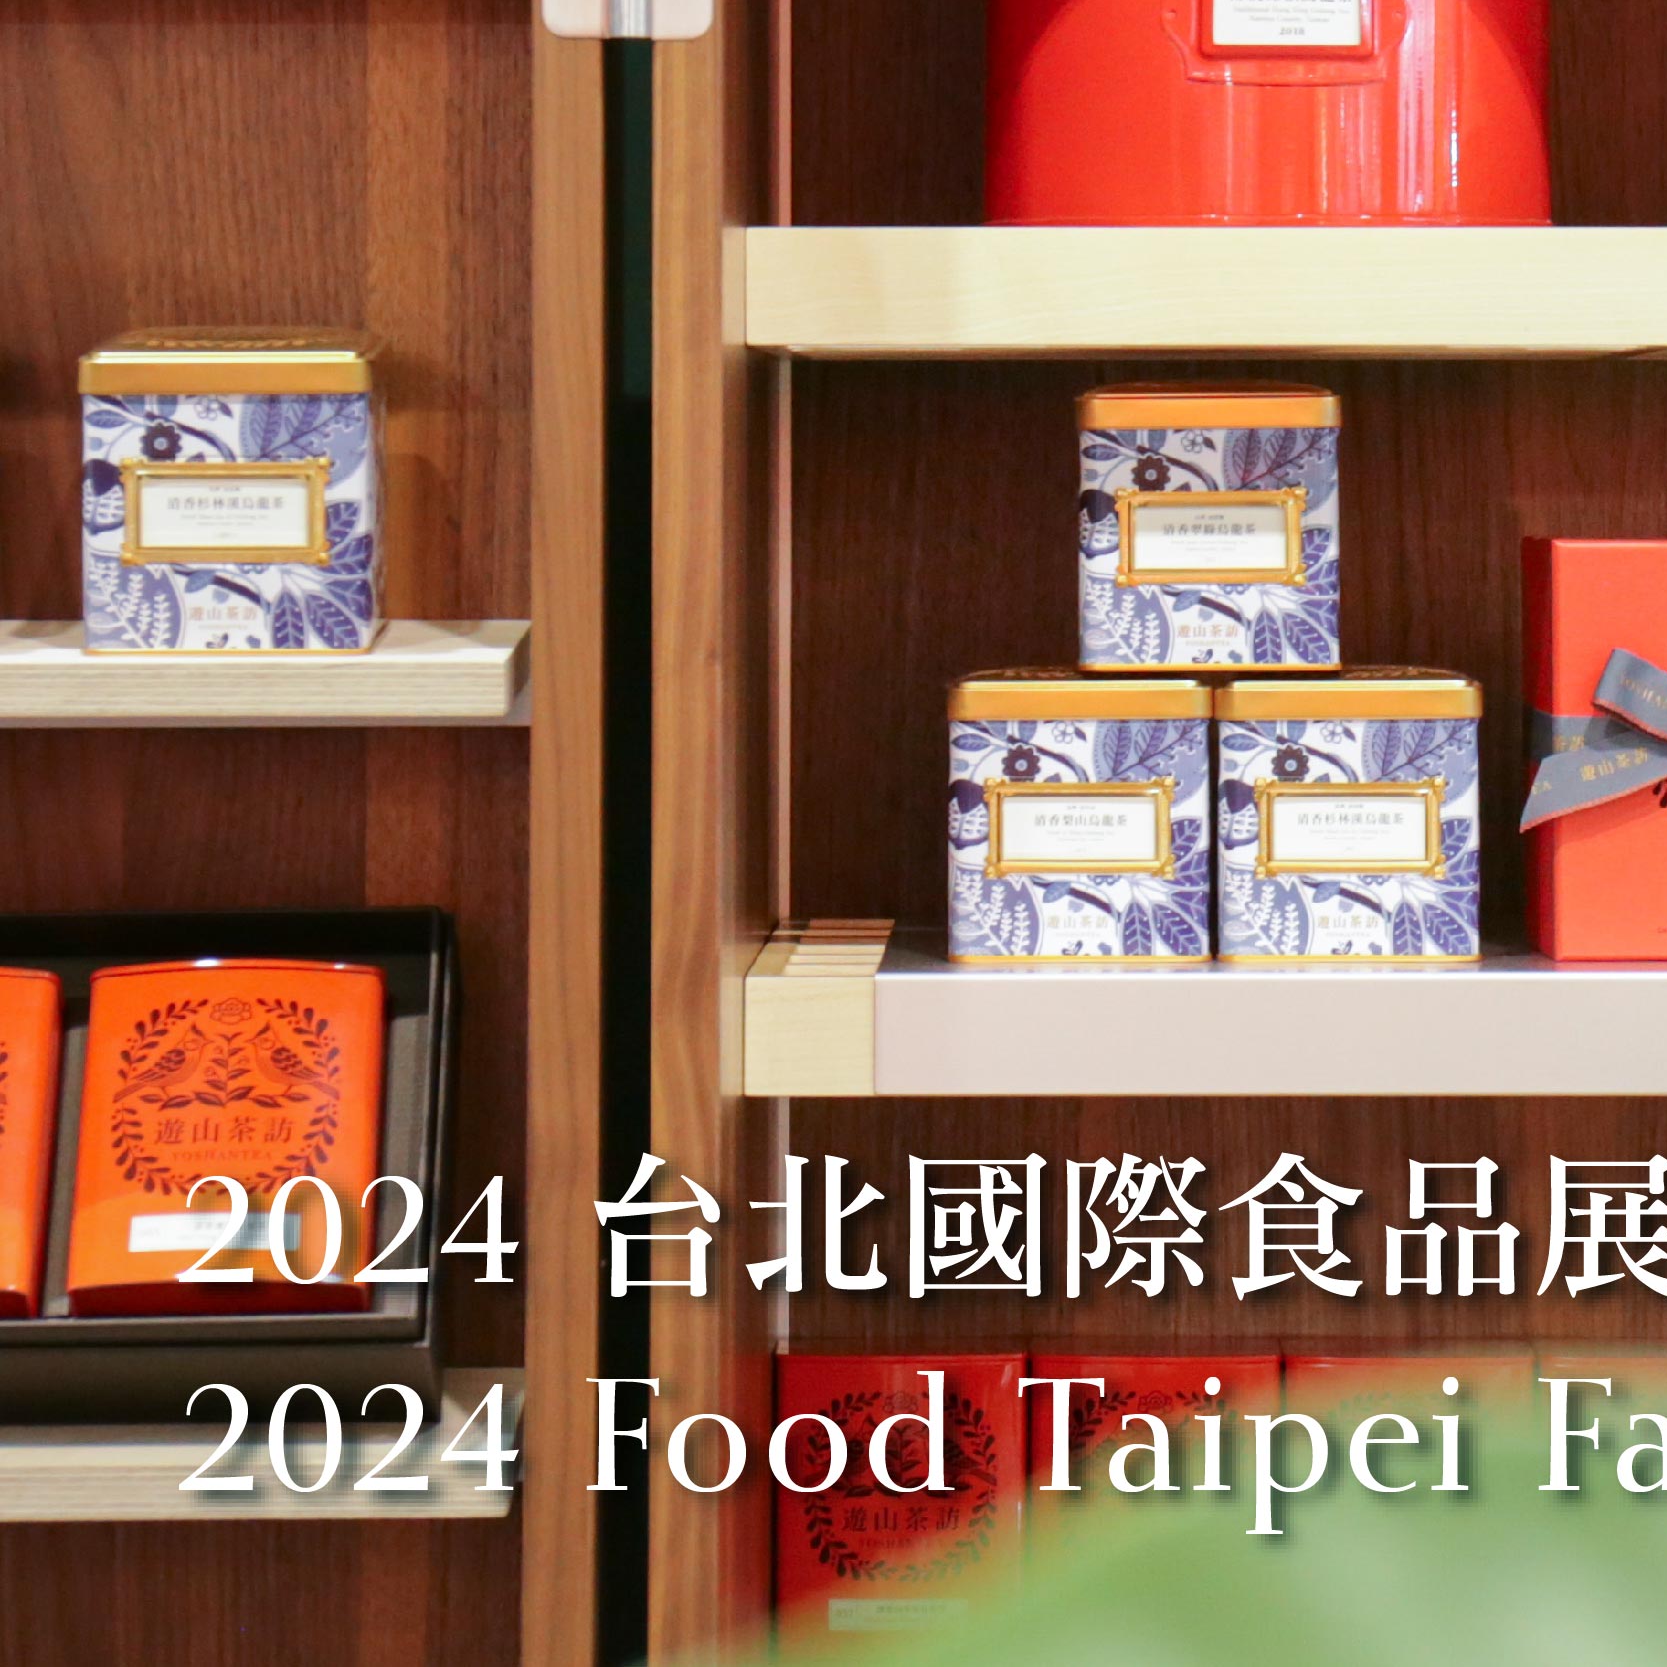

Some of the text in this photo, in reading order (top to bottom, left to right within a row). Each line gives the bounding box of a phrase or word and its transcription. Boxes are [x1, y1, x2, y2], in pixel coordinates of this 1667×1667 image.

[155, 1116, 295, 1145] 遊山茶訪
[172, 1149, 273, 1162] YOSHANTEA
[842, 1506, 961, 1532] 遊山茶訪
